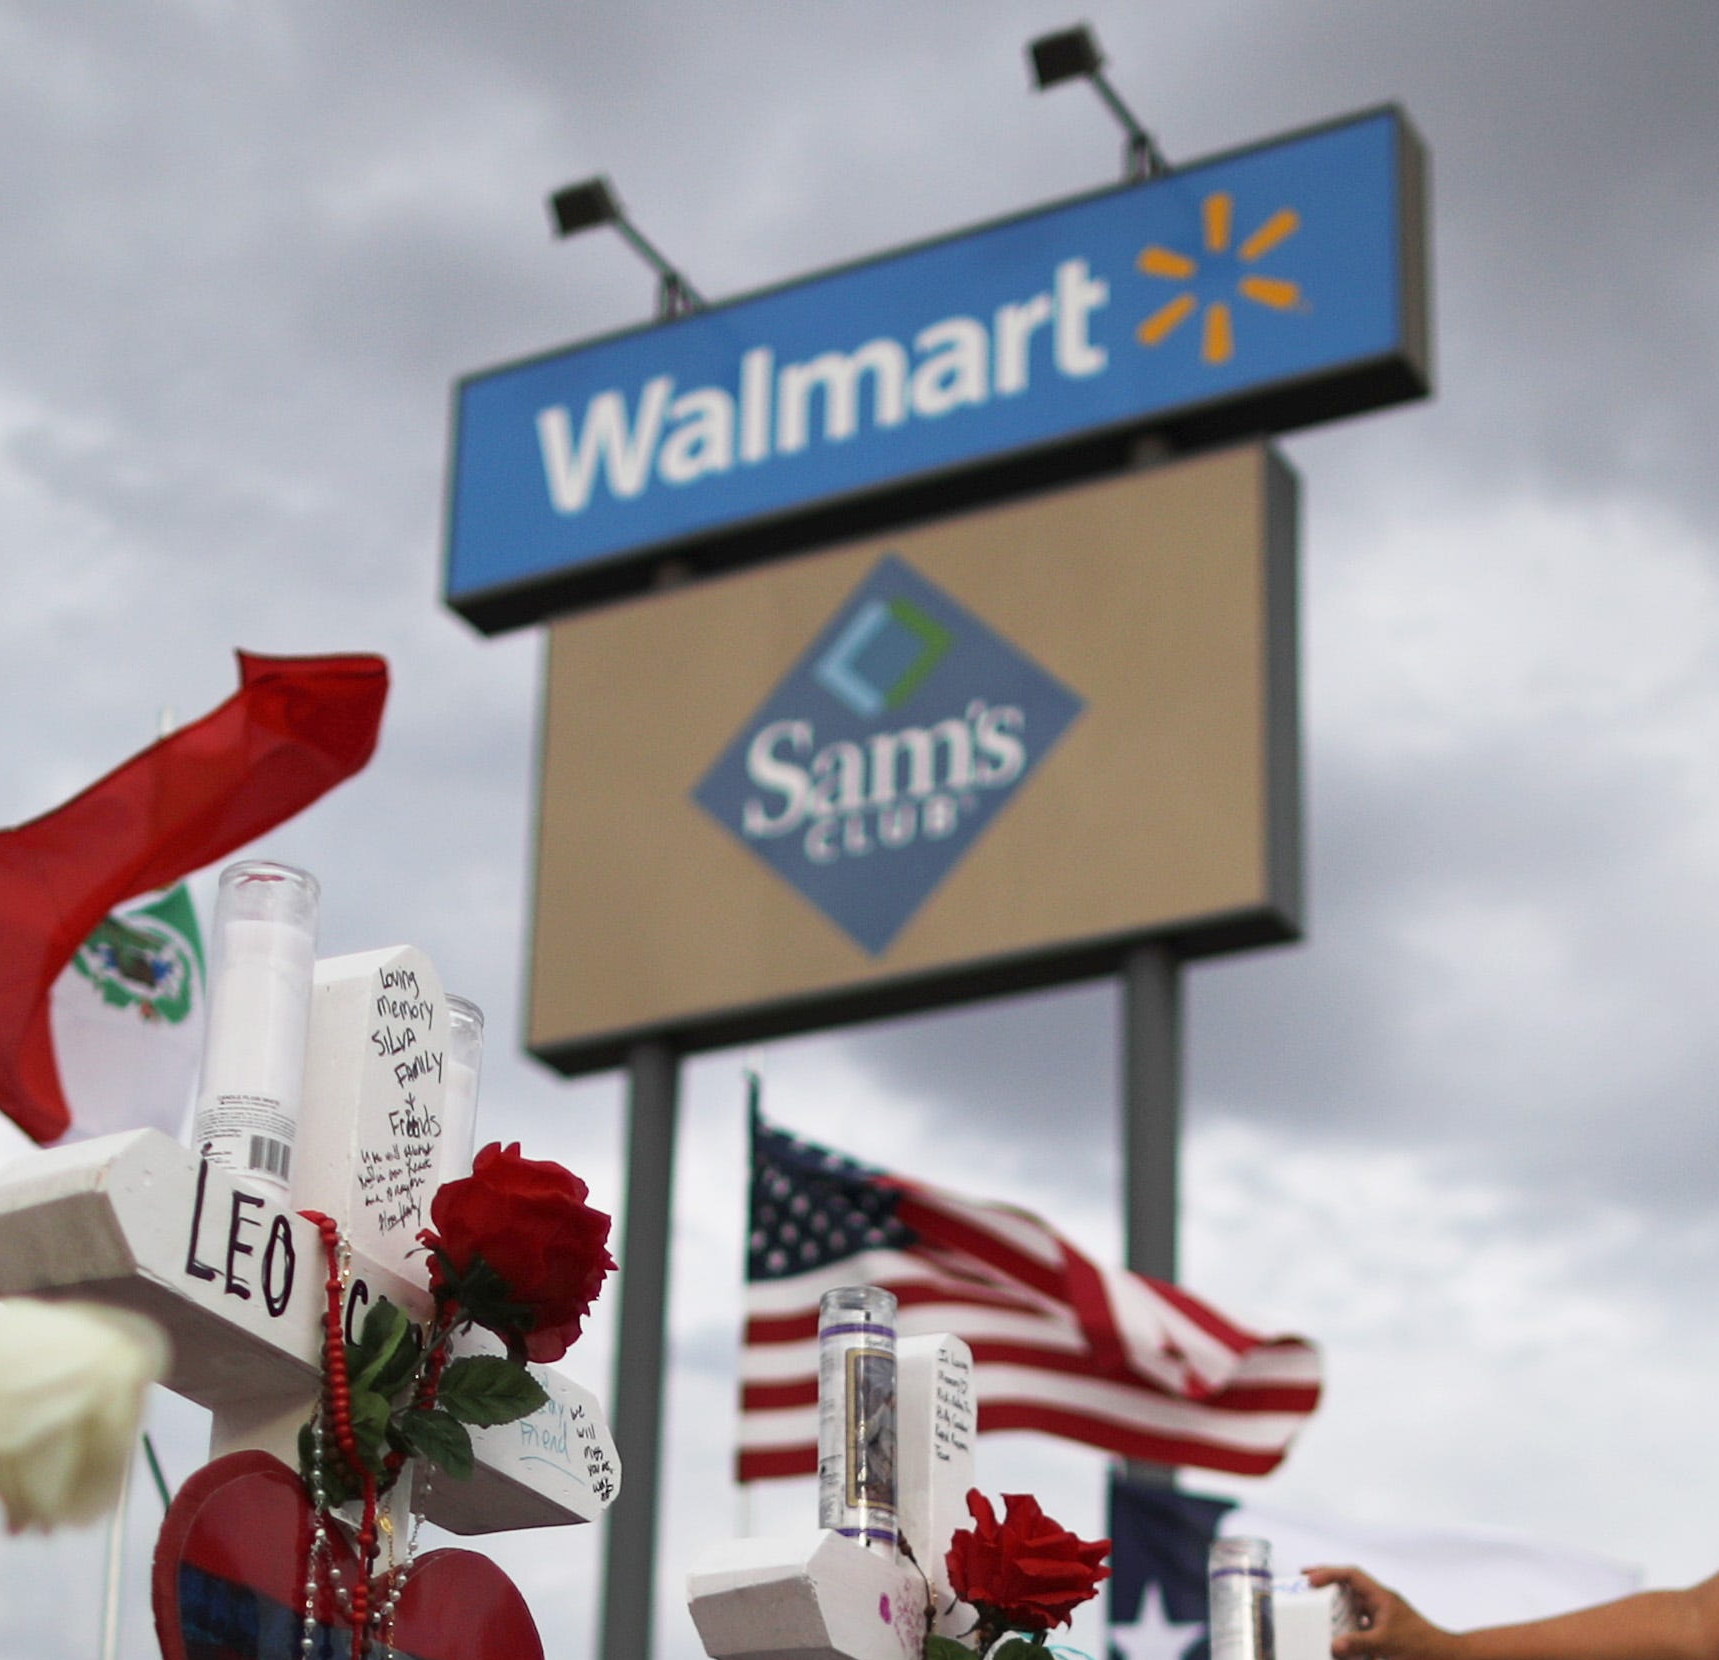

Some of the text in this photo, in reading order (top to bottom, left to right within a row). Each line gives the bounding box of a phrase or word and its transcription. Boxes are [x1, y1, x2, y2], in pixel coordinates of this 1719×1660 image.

[537, 257, 1109, 516] Walmart
[743, 699, 1026, 839] Sam's
[804, 795, 958, 864] CLUB
[379, 967, 419, 1000] Loving
[372, 1027, 416, 1056] SILVA
[394, 1051, 443, 1089] FAMILY
[183, 1141, 297, 1317] LEO
